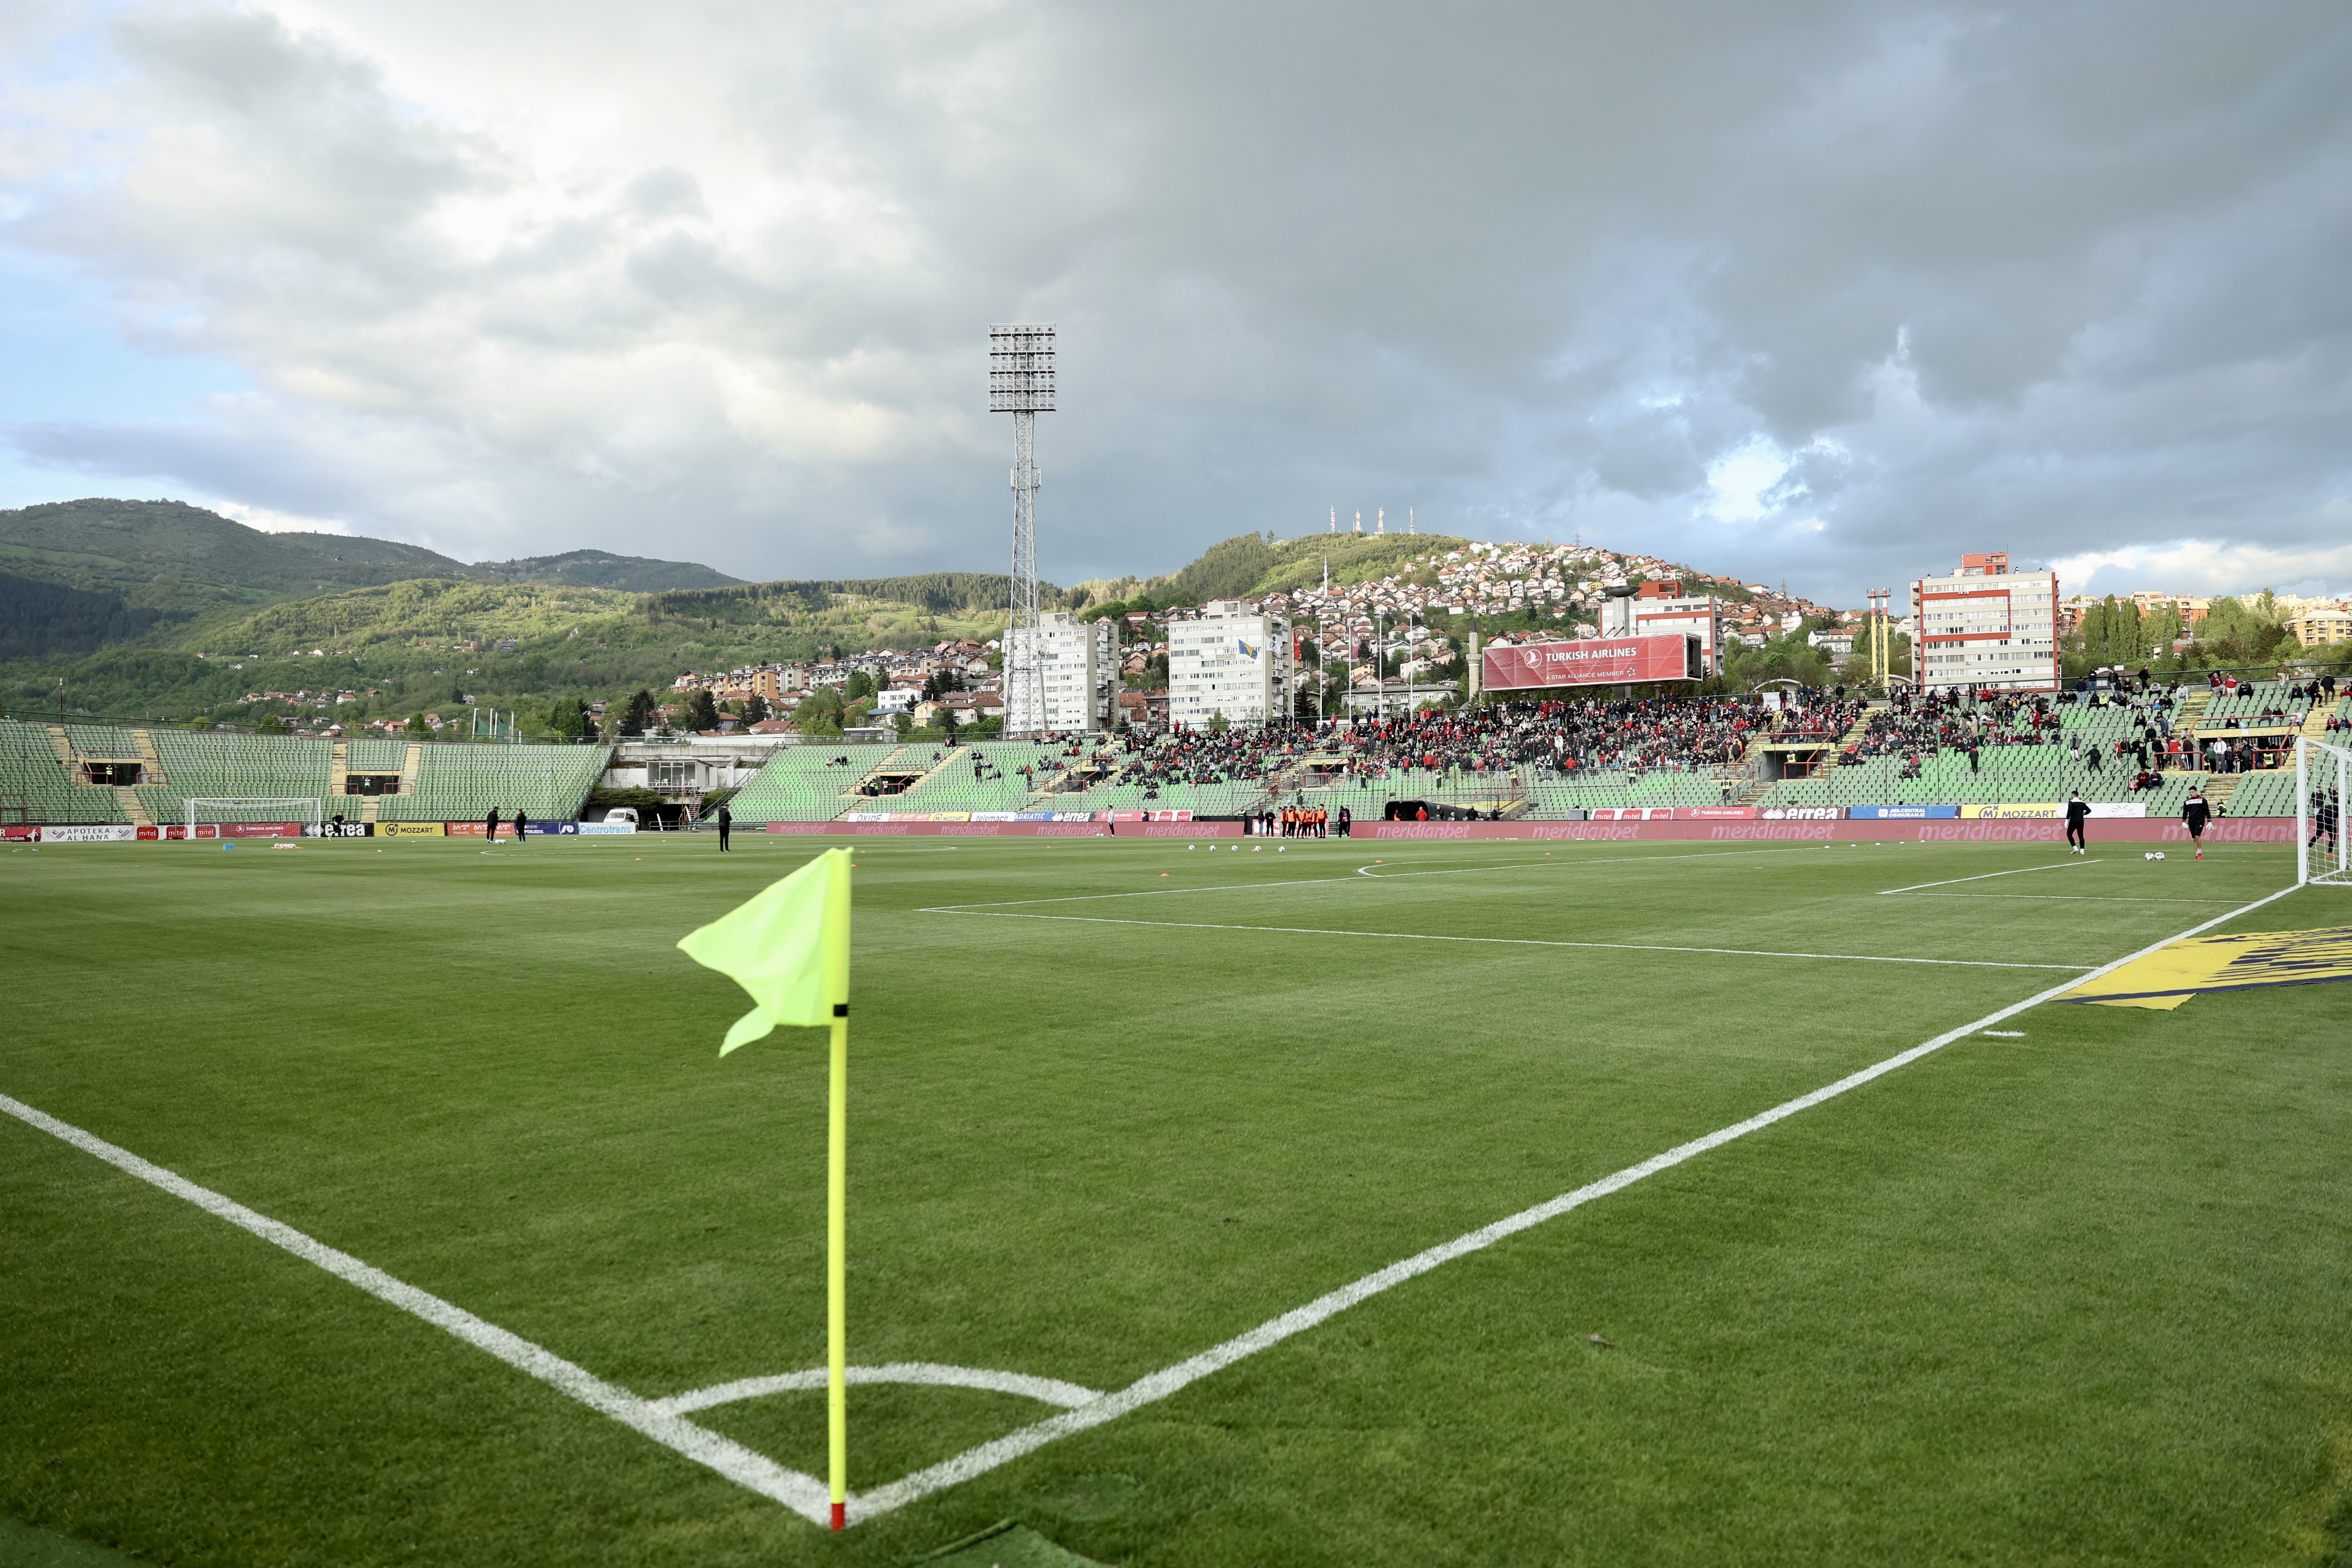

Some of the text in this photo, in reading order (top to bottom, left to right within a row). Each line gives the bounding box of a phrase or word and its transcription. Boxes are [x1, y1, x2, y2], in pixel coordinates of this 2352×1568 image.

[1546, 647, 1636, 662] TURKISH AIRLINES
[1063, 812, 1090, 822] errea
[1786, 807, 1838, 819] errea
[325, 824, 365, 836] erea
[579, 824, 631, 834] Centrotrans
[780, 823, 826, 834] meridianbet
[856, 823, 908, 835] meridianbet
[941, 823, 999, 835] meridianbet
[1037, 822, 1103, 836] meridianbet
[1145, 822, 1220, 837] meridianbet
[1376, 822, 1470, 839] meridianbet
[1532, 821, 1640, 839] meridianbet
[1711, 821, 1835, 839] meridianbet
[1918, 820, 2062, 840] meridianbet
